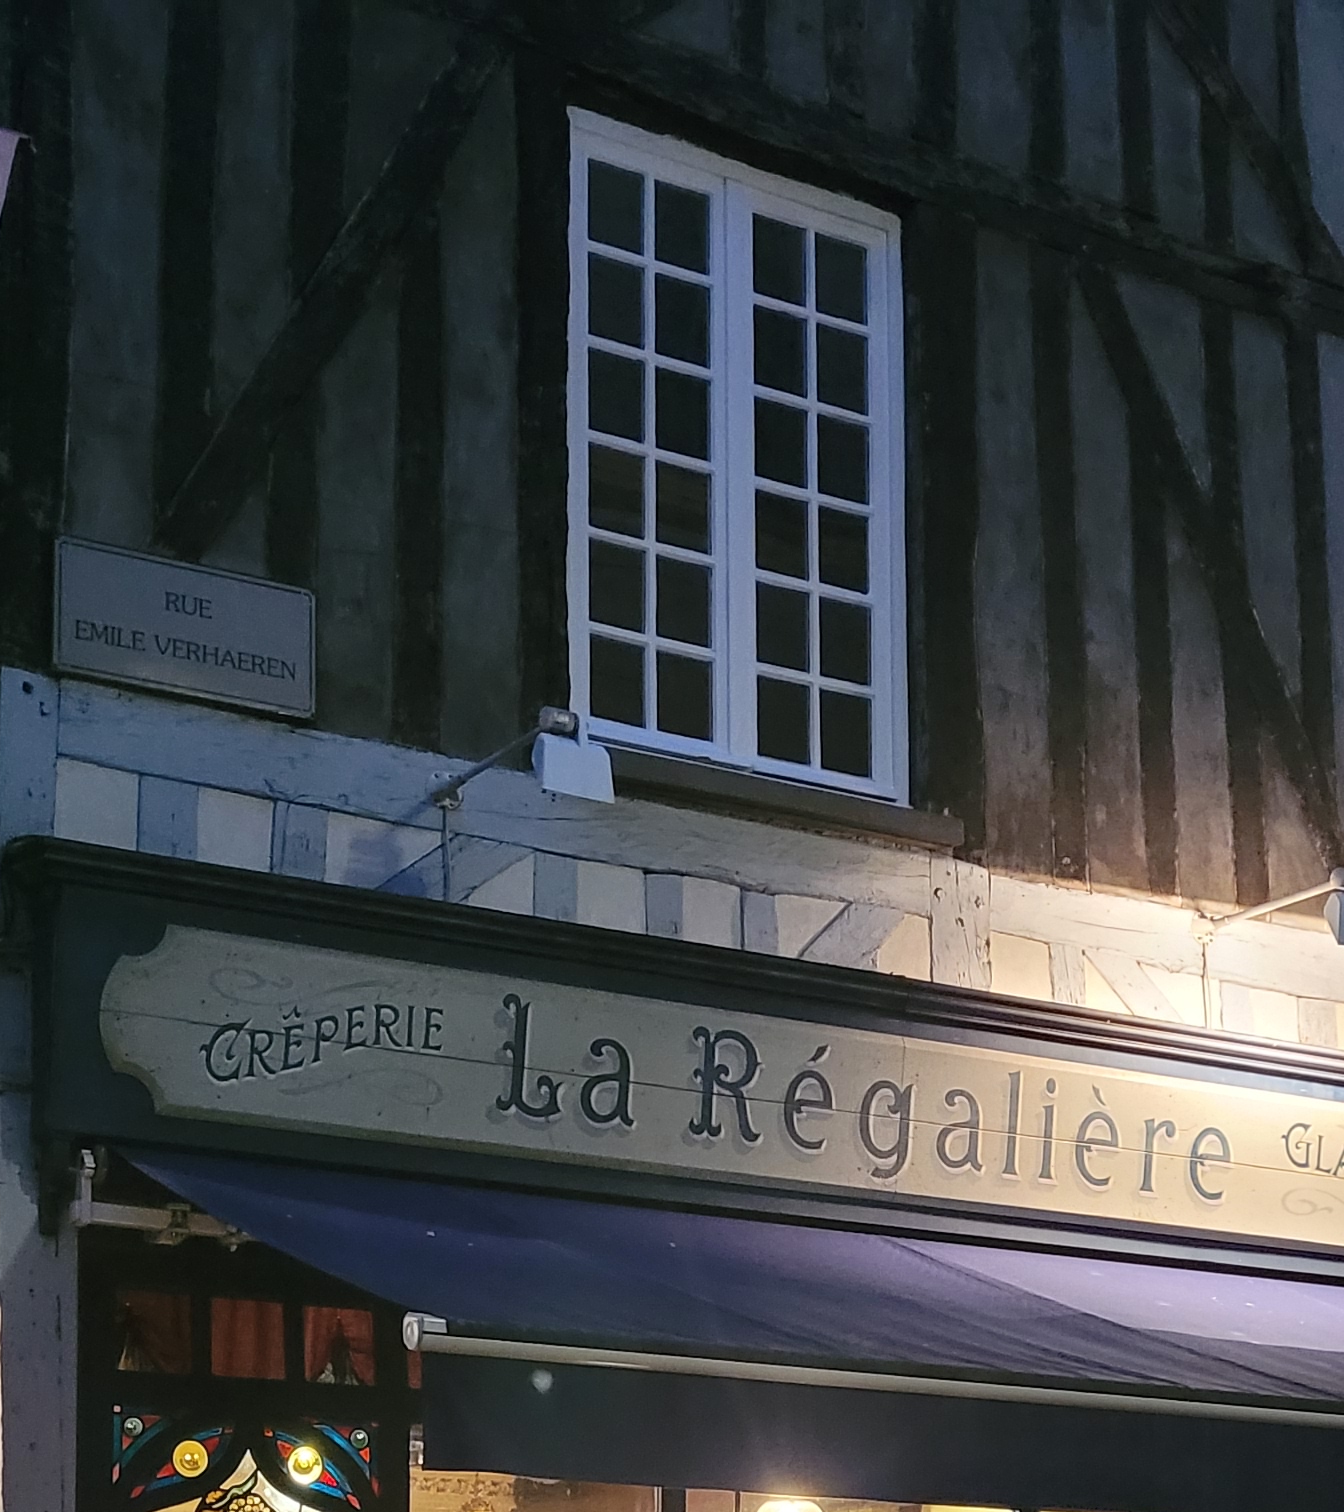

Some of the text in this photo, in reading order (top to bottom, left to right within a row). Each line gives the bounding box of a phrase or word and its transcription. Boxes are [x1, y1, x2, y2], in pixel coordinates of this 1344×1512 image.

[164, 591, 213, 619] RUE
[74, 619, 298, 681] EMILE VERHAEREN
[200, 1005, 445, 1083] CRÊPERIE
[495, 993, 636, 1130] La
[688, 1025, 1233, 1203] Régalière
